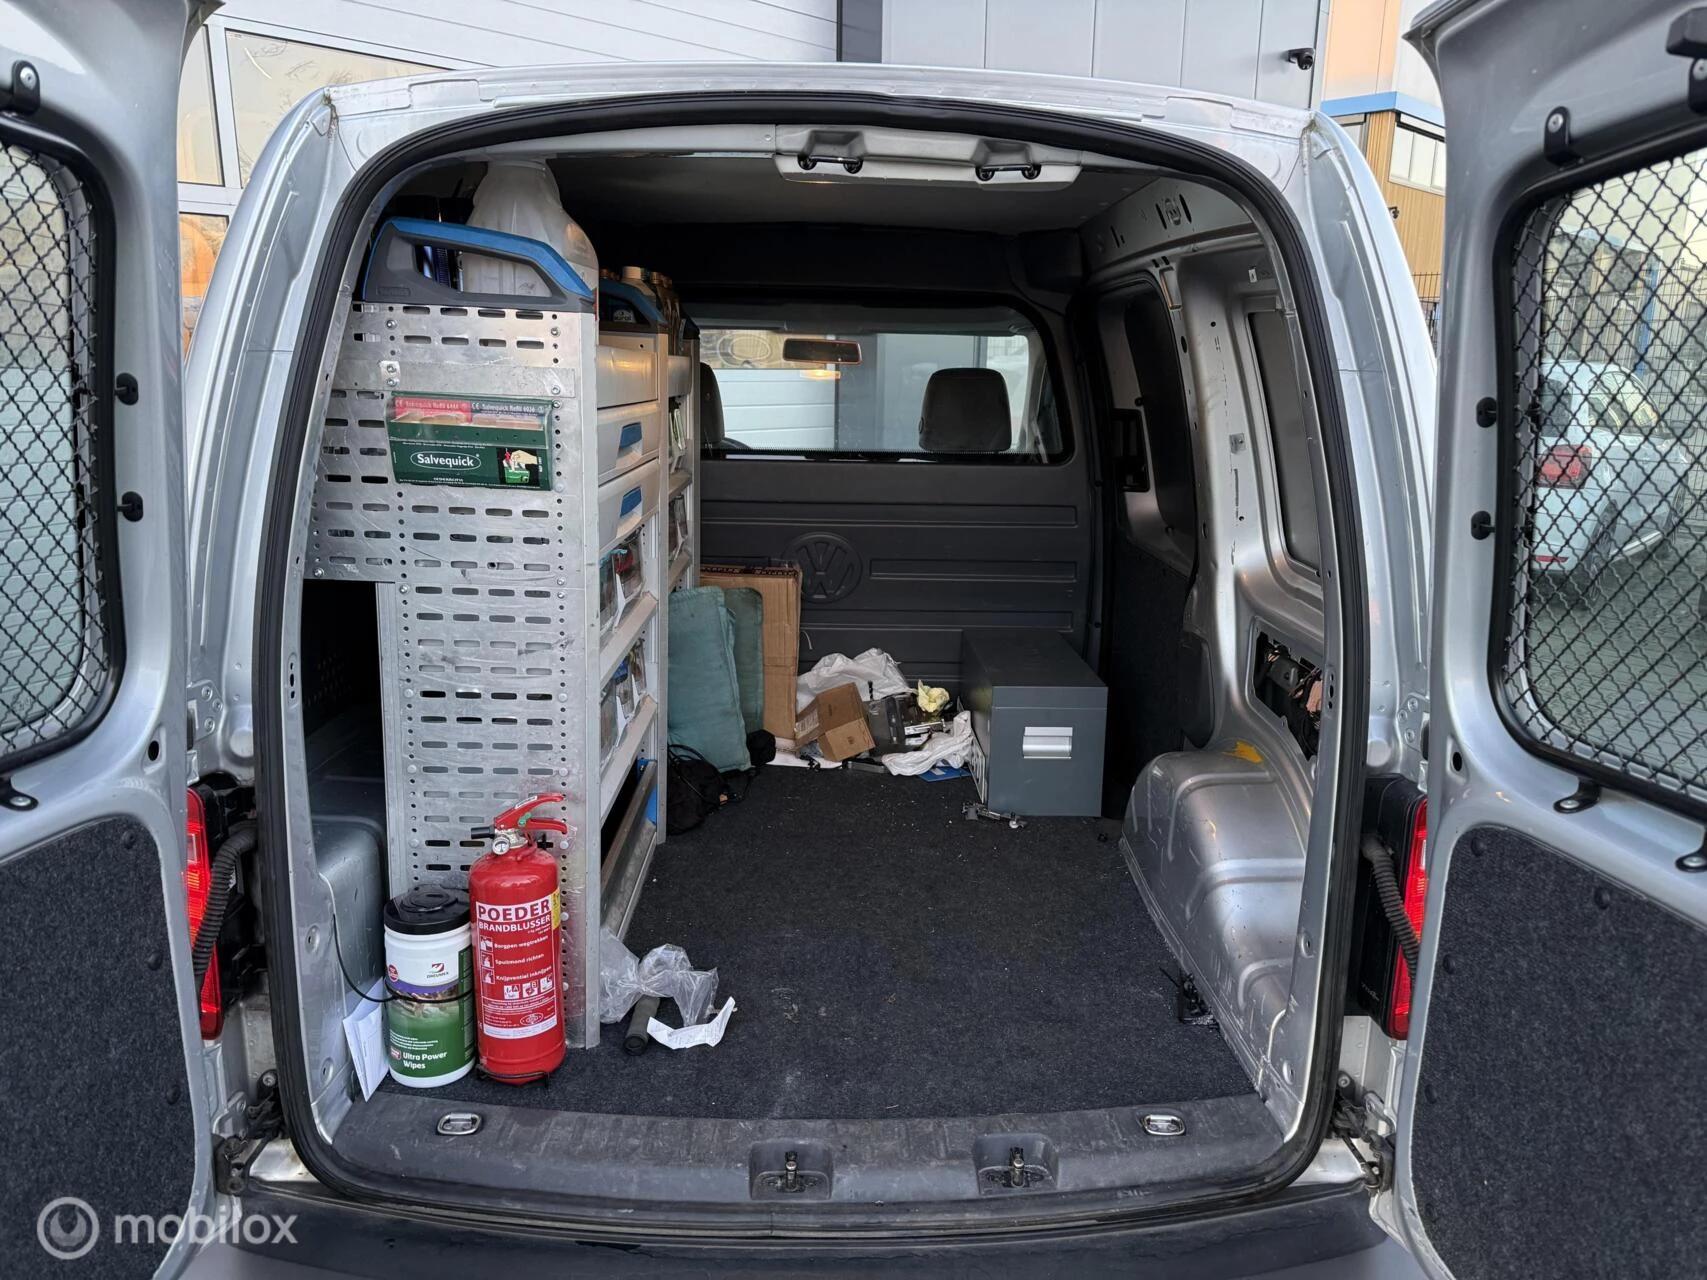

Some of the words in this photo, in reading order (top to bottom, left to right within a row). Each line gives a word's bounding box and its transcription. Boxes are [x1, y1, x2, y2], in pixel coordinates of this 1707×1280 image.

[417, 453, 474, 469] Salvequick
[478, 899, 550, 921] POEDER
[478, 914, 551, 932] BRANDBLUSSER
[402, 1051, 421, 1061] Ultra
[421, 1051, 448, 1060] Power
[402, 1060, 426, 1070] Wipes
